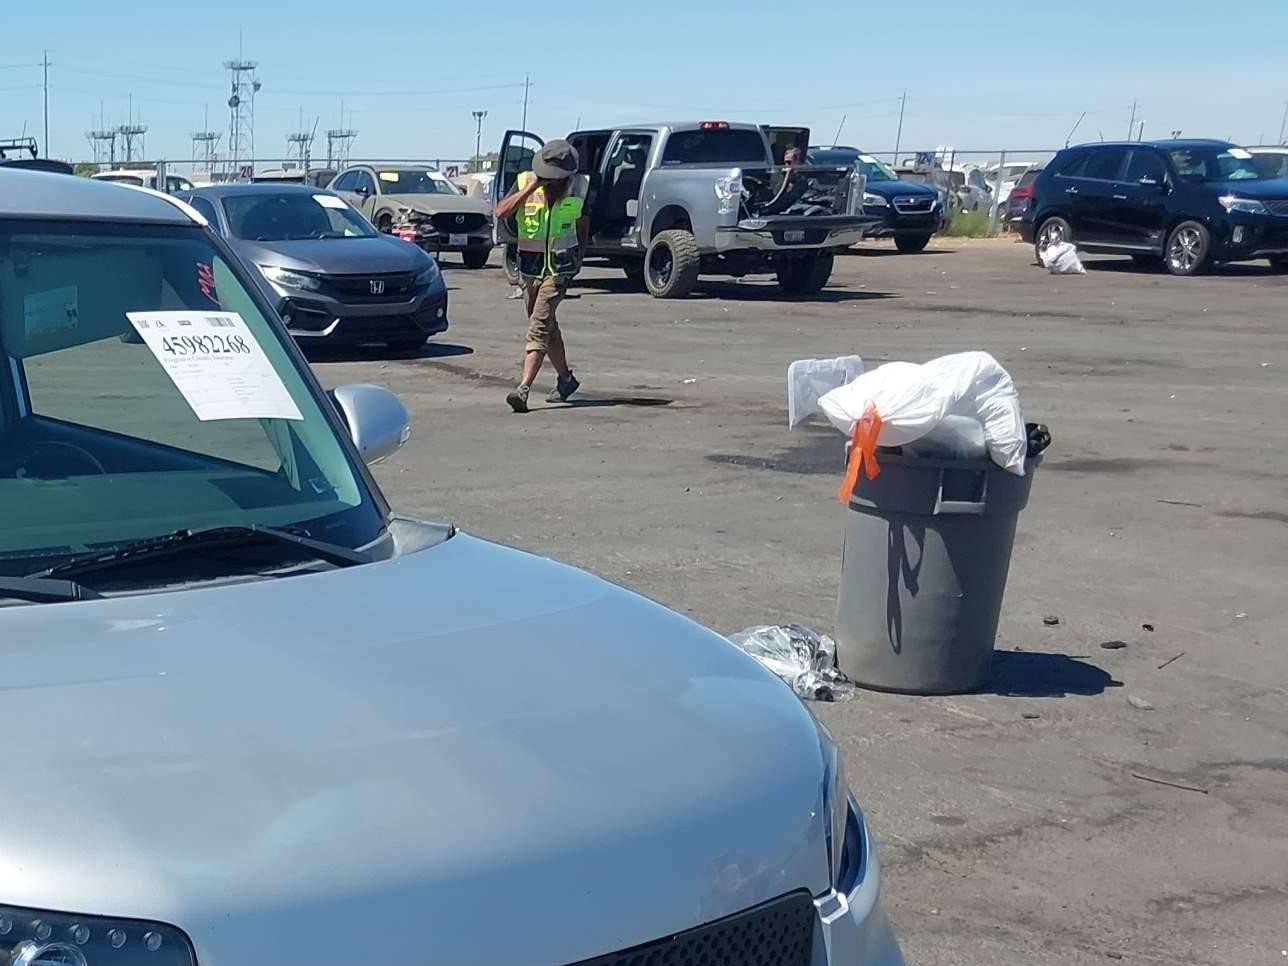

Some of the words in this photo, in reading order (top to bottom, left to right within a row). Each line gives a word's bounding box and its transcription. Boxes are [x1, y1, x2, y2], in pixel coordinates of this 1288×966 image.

[241, 166, 253, 178] 20
[446, 166, 458, 178] 21
[162, 335, 251, 355] 45982268
